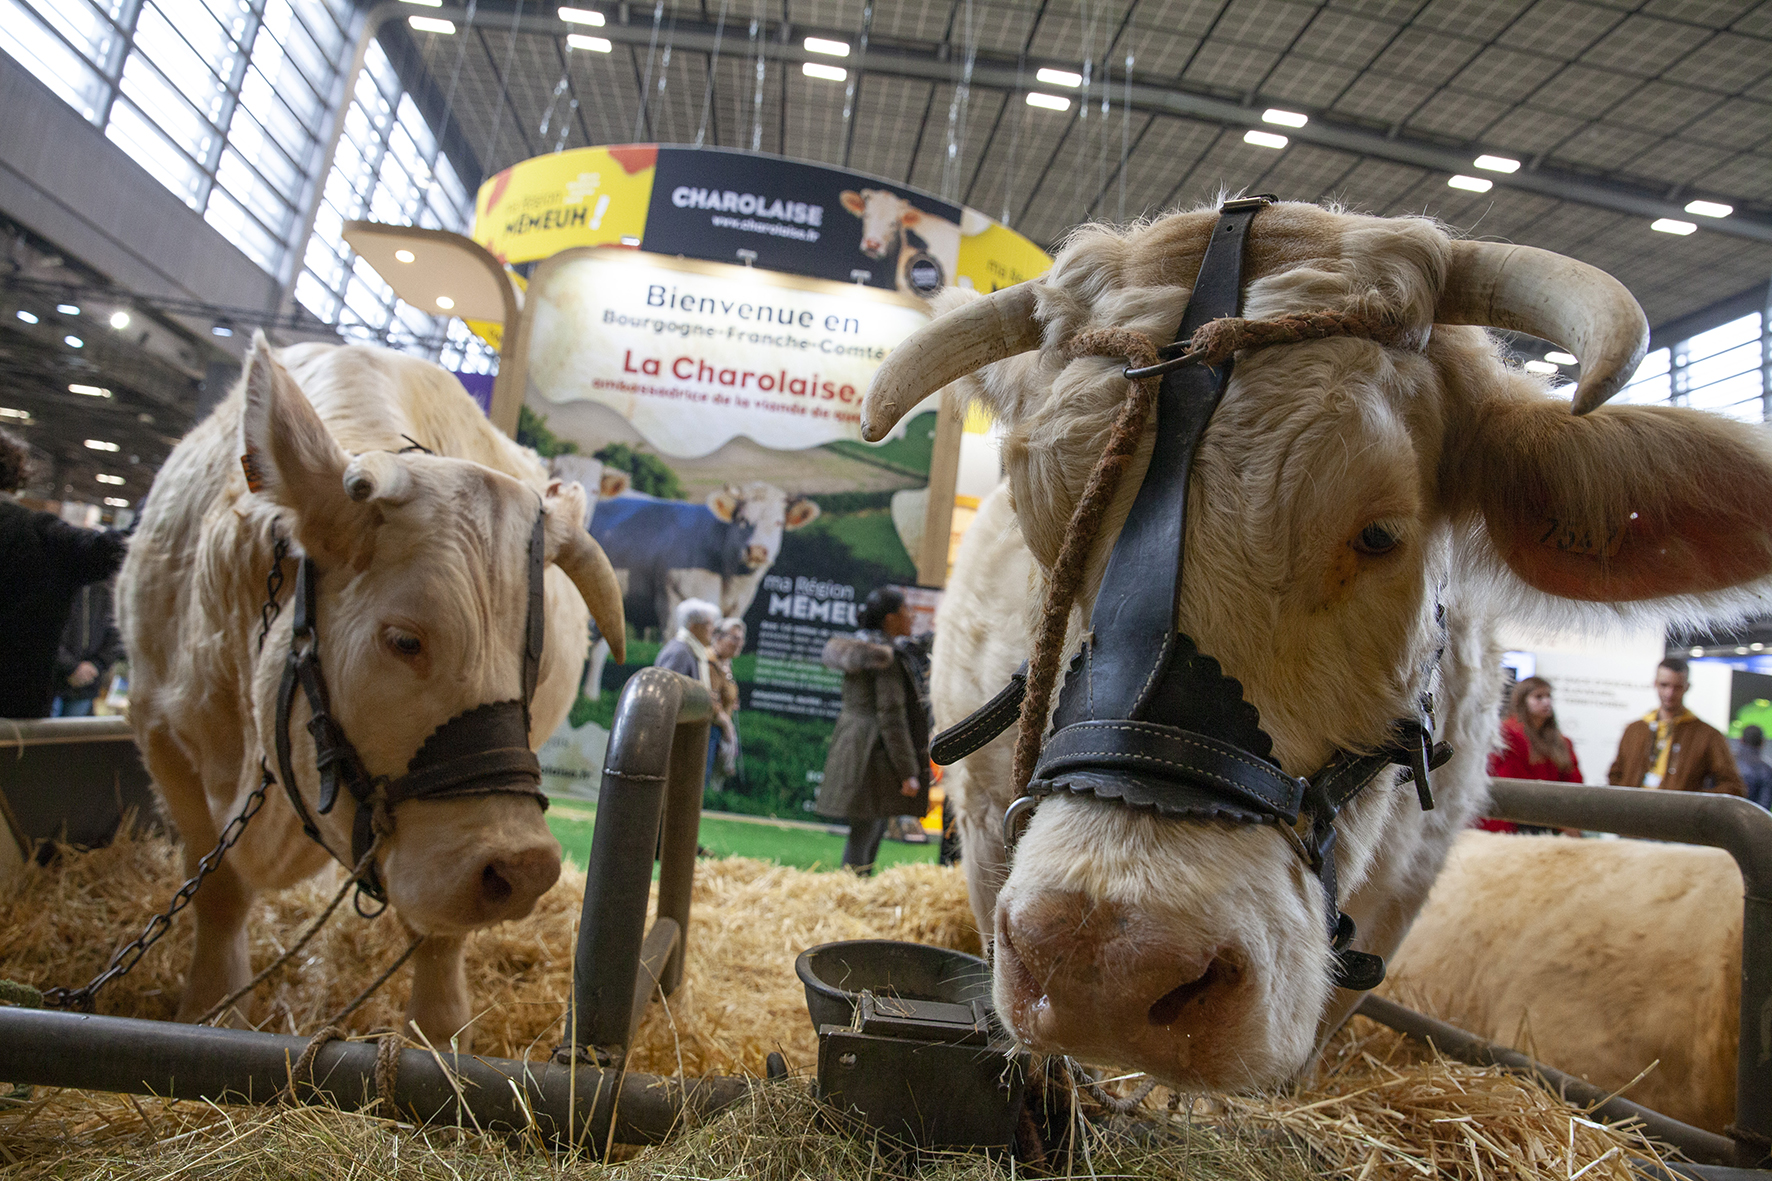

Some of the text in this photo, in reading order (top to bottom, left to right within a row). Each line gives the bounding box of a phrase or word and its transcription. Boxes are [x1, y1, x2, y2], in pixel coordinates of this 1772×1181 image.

[671, 186, 824, 227] CHAROLAISE
[711, 216, 820, 243] www.charolaise.fr
[647, 285, 860, 334] Bienvenue en
[624, 350, 864, 404] La Charolaise,
[591, 378, 709, 402] ambassadrice
[712, 393, 731, 405] de
[735, 396, 750, 408] la
[755, 398, 806, 416] viande
[811, 405, 830, 419] de
[763, 574, 855, 602] ma Région
